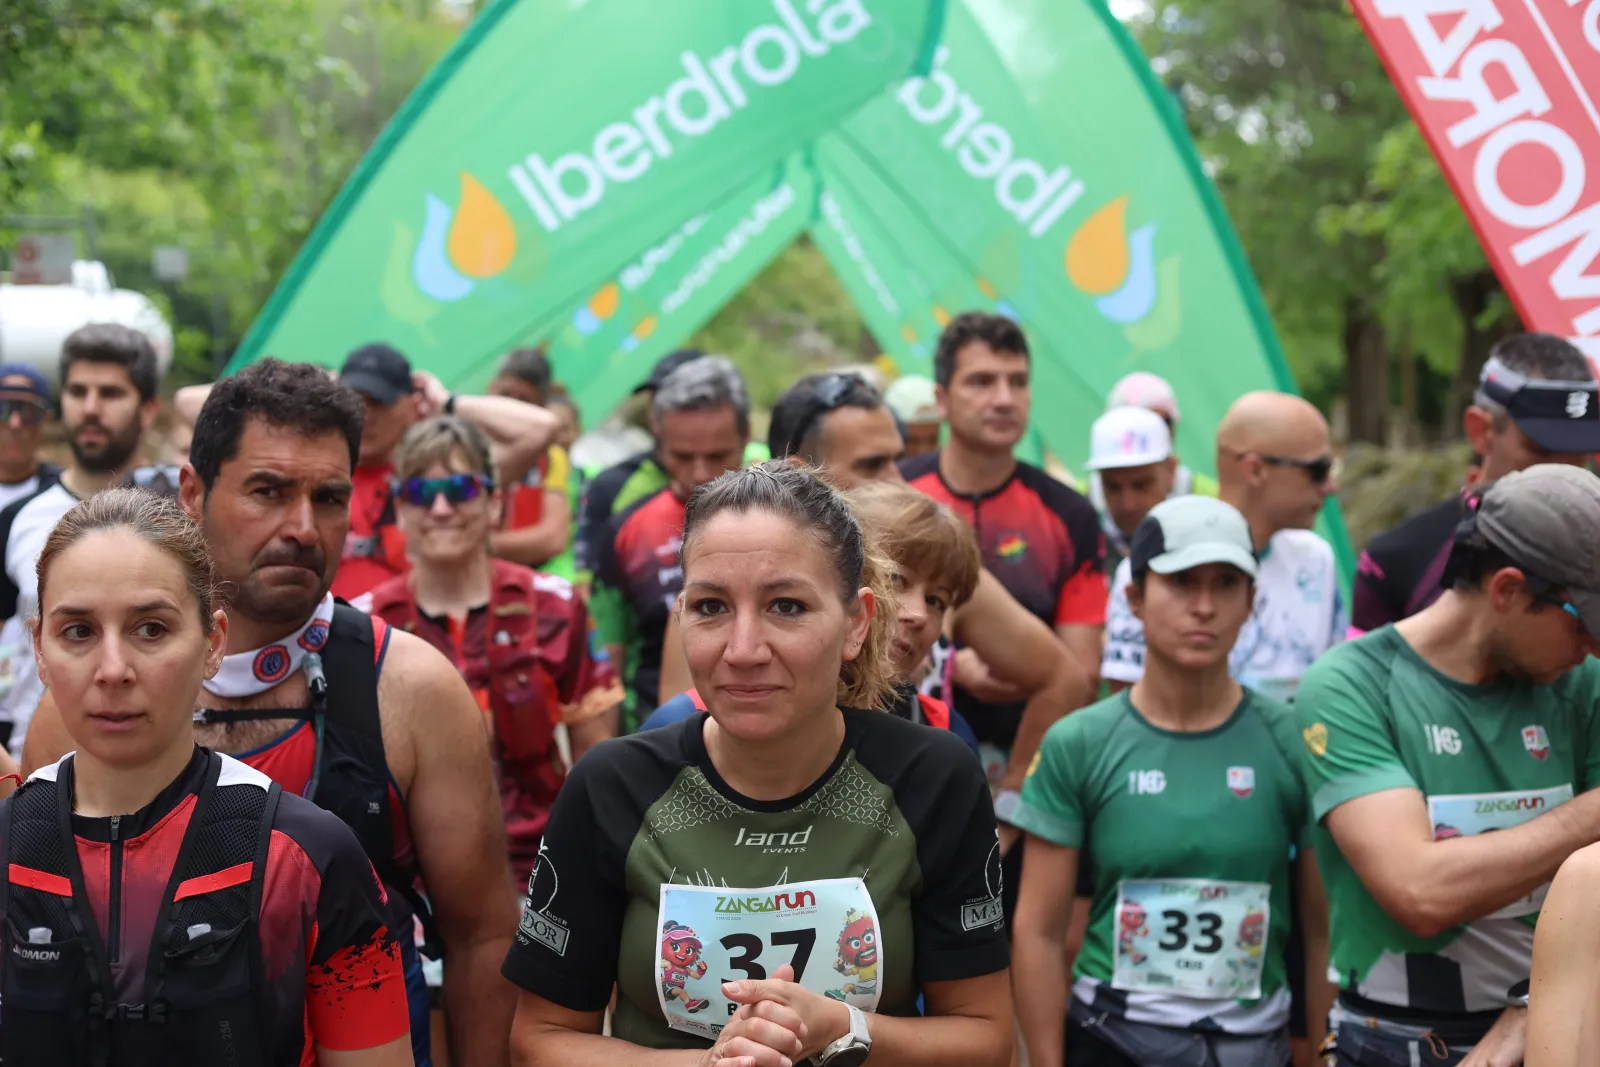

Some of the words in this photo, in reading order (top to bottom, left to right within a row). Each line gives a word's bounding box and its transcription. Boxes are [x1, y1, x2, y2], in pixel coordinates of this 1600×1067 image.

[508, 0, 870, 231] Iberdrola
[734, 825, 813, 846] land
[762, 846, 807, 854] EVENTS
[1158, 909, 1223, 954] 33
[719, 928, 816, 984] 37
